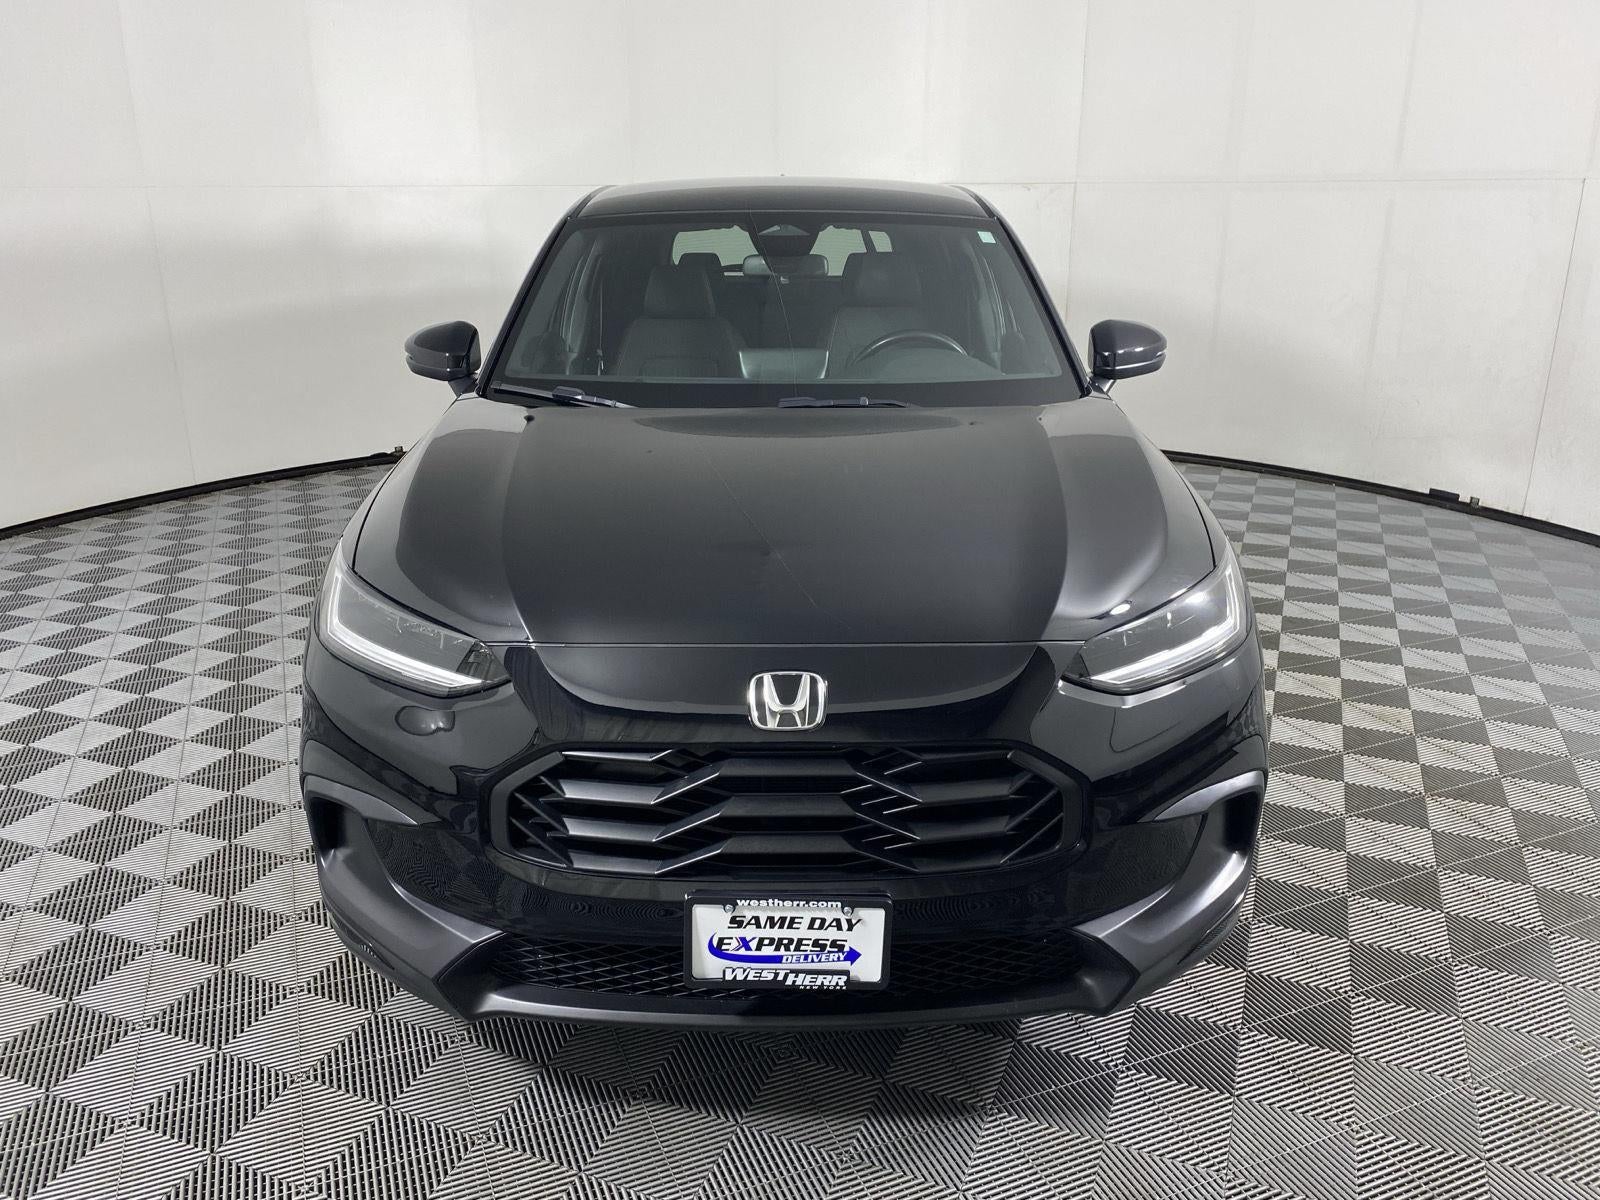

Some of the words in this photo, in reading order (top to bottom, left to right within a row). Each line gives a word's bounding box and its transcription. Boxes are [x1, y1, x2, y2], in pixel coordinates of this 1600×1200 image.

[737, 899, 841, 908] westherr.com
[728, 915, 803, 930] SAME
[807, 917, 862, 932] DAY
[715, 936, 848, 953] EXPRESS
[782, 952, 848, 964] DELIVERY
